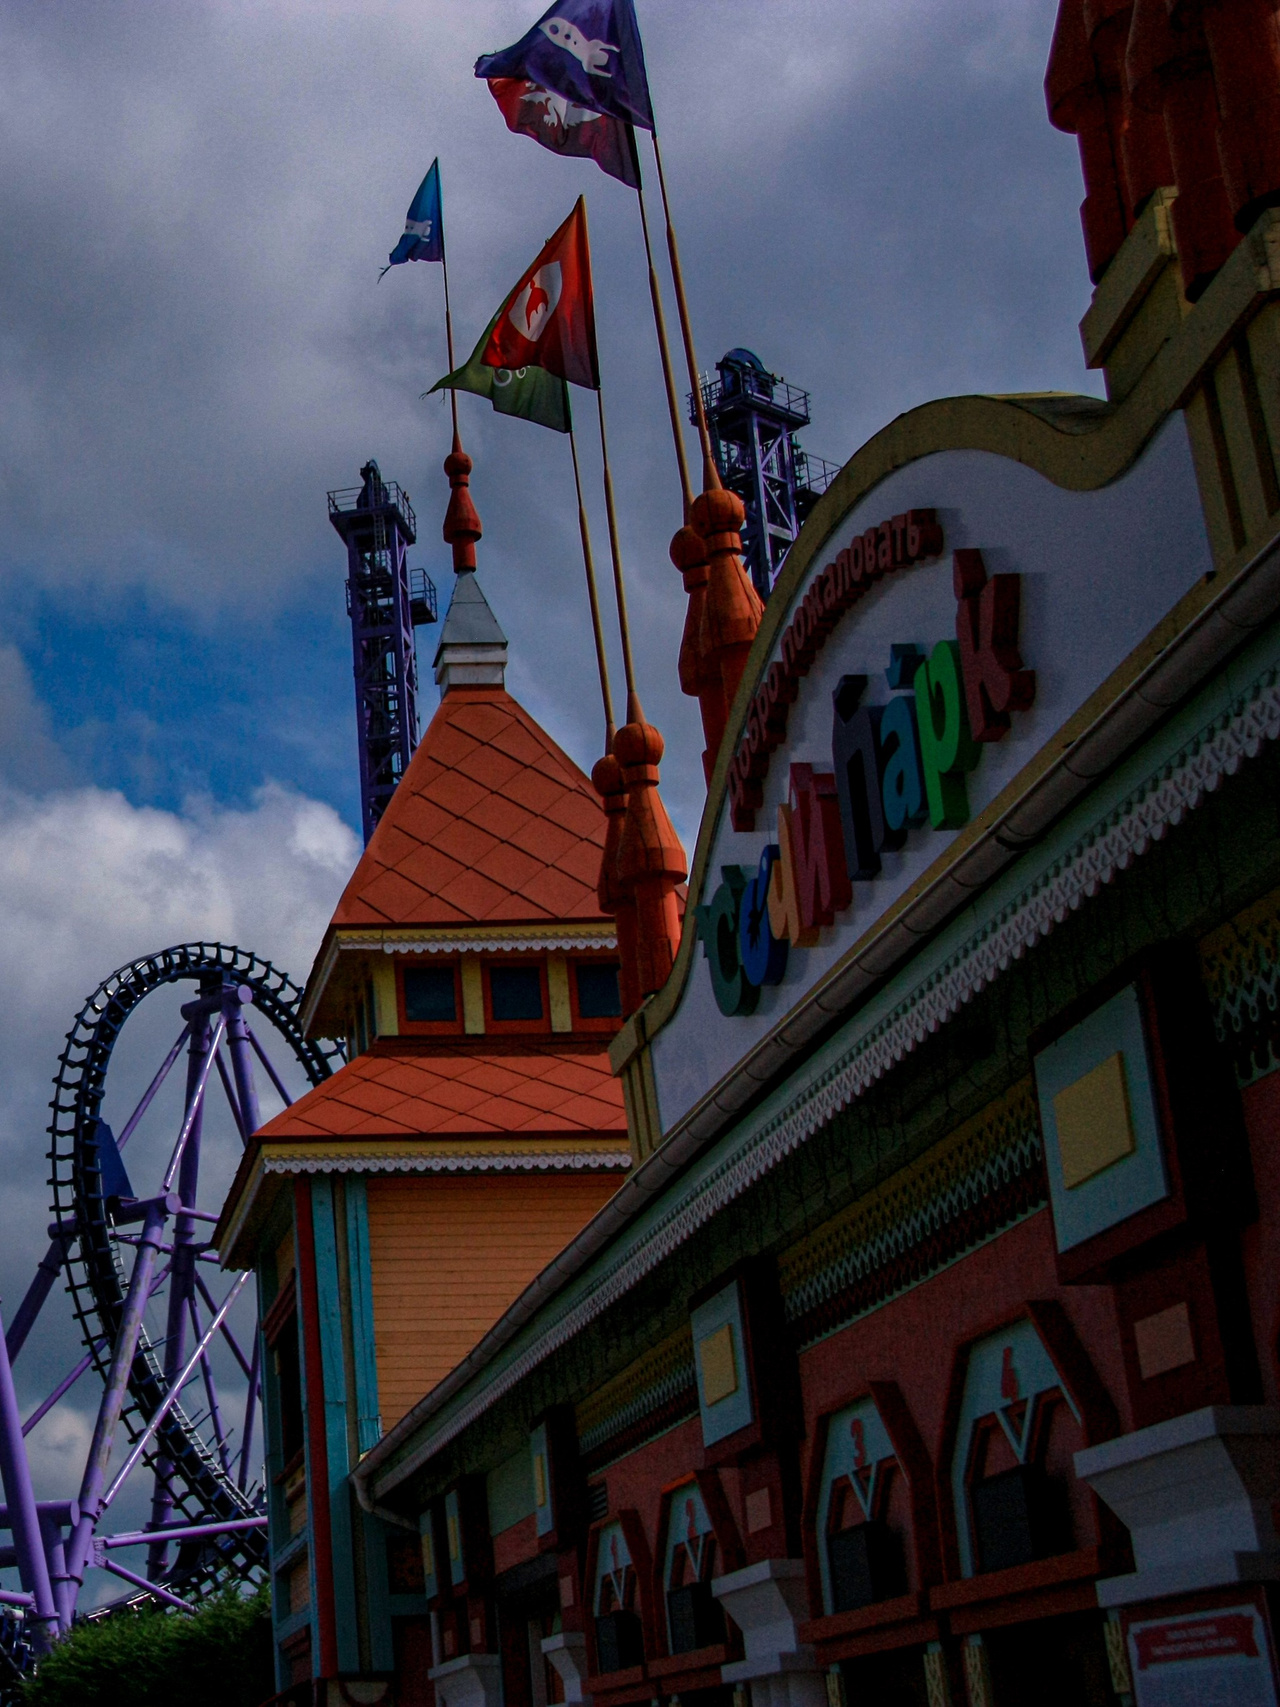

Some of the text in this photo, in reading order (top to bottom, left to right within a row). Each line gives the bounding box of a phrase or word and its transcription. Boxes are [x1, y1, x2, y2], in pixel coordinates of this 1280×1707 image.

[781, 509, 939, 677] пожаловать
[1002, 1346, 1019, 1402] 4
[851, 1419, 866, 1468] 3
